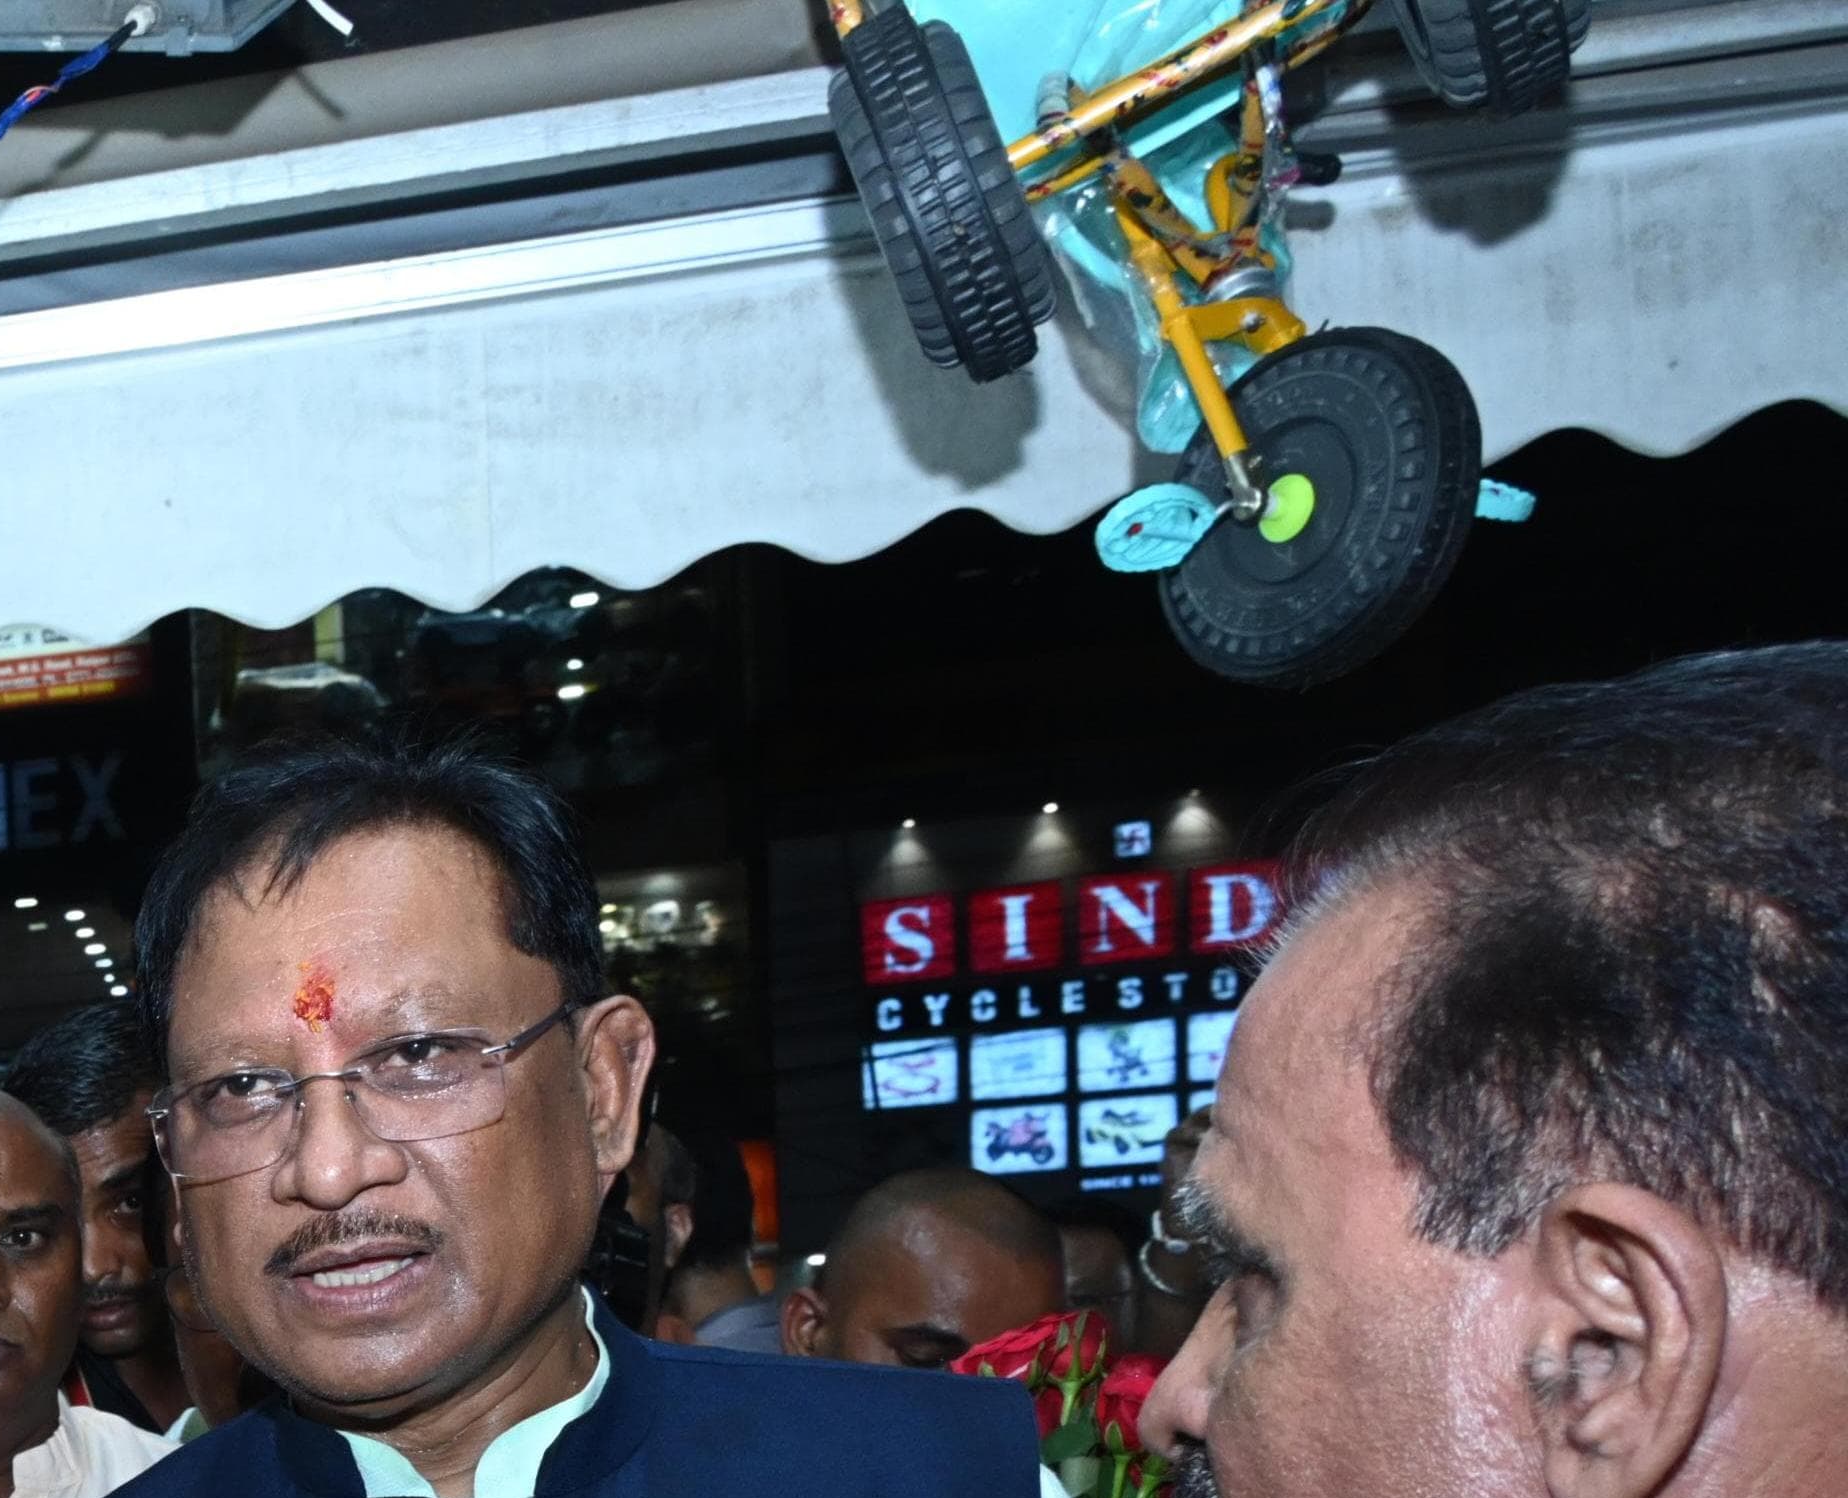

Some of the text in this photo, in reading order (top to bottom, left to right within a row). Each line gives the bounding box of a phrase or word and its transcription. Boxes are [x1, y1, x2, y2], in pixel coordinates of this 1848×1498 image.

[883, 873, 1276, 973] SIND
[876, 967, 1239, 1031] CYCLE STO
